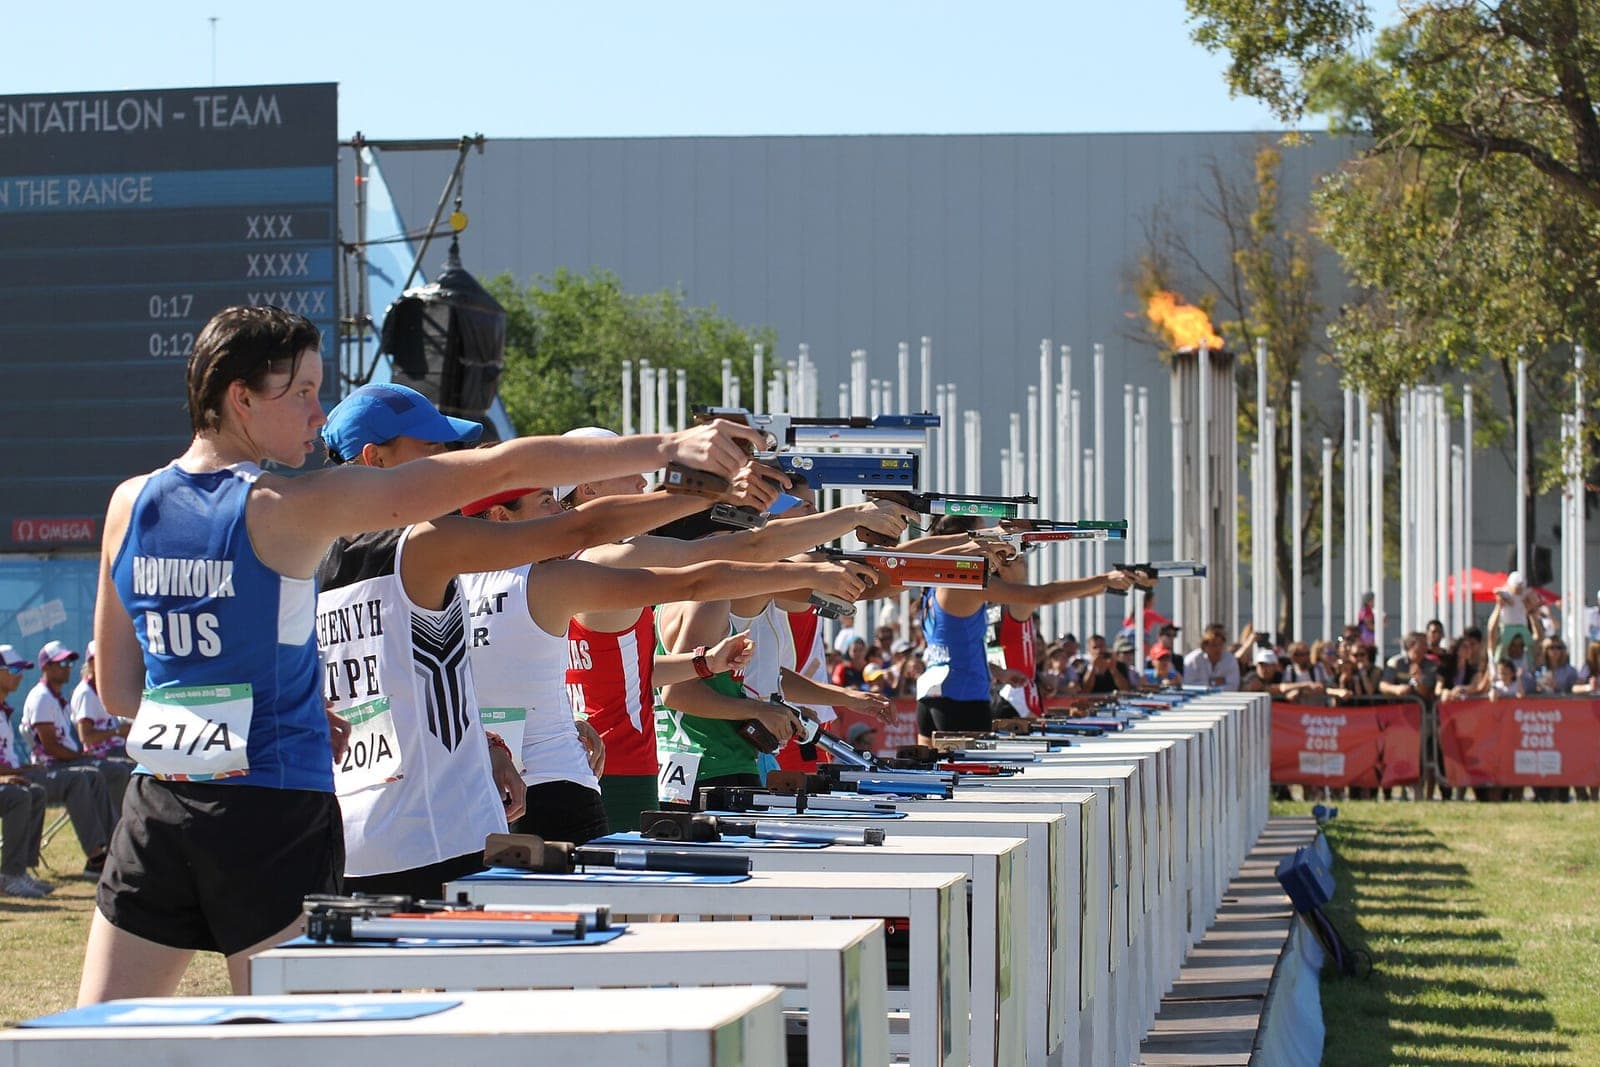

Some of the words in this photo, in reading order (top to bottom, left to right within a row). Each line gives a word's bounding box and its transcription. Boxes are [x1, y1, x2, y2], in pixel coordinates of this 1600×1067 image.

[193, 94, 283, 129] TEAM
[15, 179, 60, 207] THE
[67, 176, 153, 206] RANGE
[246, 215, 293, 239] XXX
[246, 252, 309, 277] XXXX
[149, 294, 194, 318] 0:17
[149, 333, 193, 357] 0:12
[39, 521, 92, 540] OMEGA
[133, 556, 236, 598] NOVIKOVA
[146, 610, 222, 658] RUS
[327, 655, 380, 702] TPE
[142, 719, 232, 756] 21/A
[341, 732, 393, 773] 20/A
